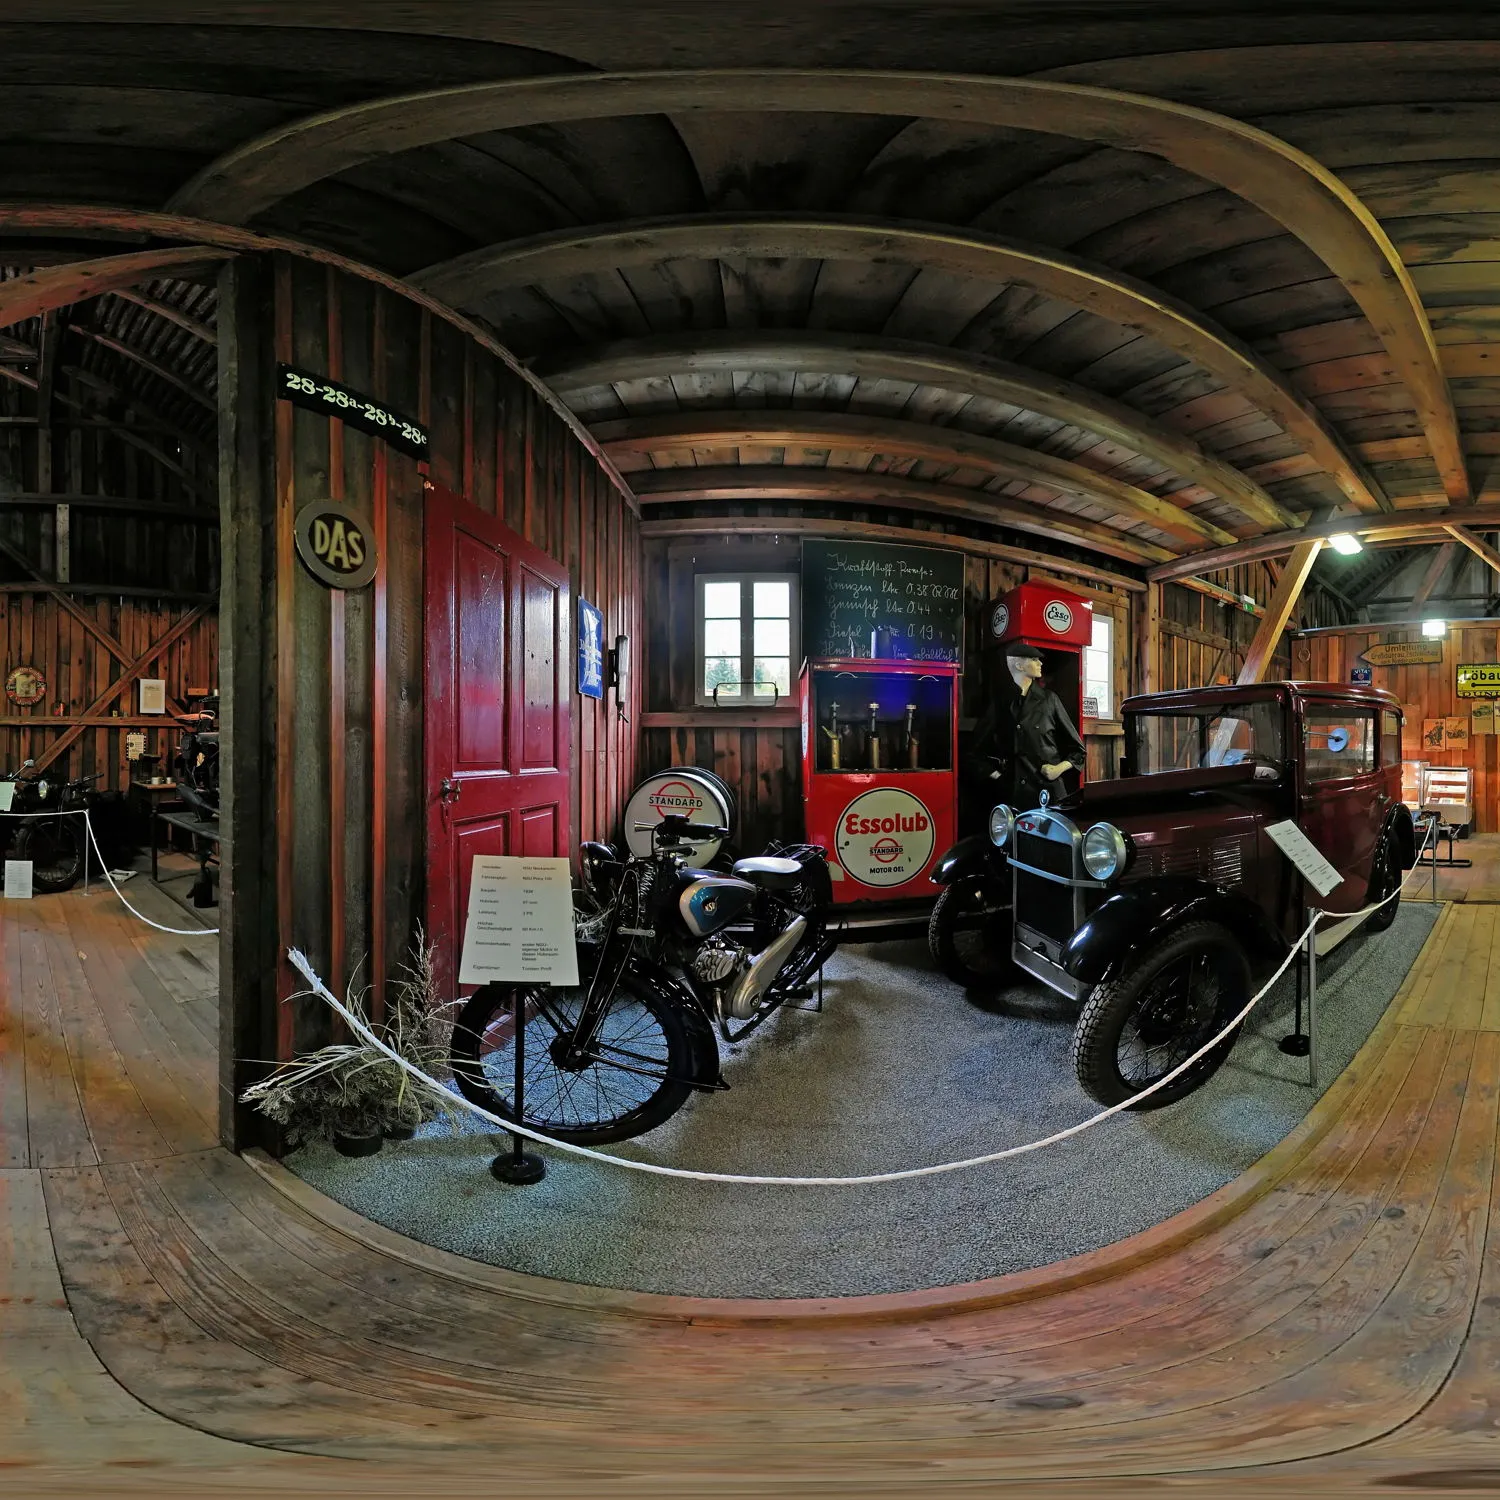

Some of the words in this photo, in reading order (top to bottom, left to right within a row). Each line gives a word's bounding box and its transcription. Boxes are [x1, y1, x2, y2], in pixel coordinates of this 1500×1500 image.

[314, 520, 365, 569] DAS
[1047, 606, 1069, 622] Esso
[649, 796, 703, 808] STANDARD
[845, 812, 928, 835] Essolub
[869, 847, 904, 855] STANDARD
[869, 866, 892, 874] MOTOR
